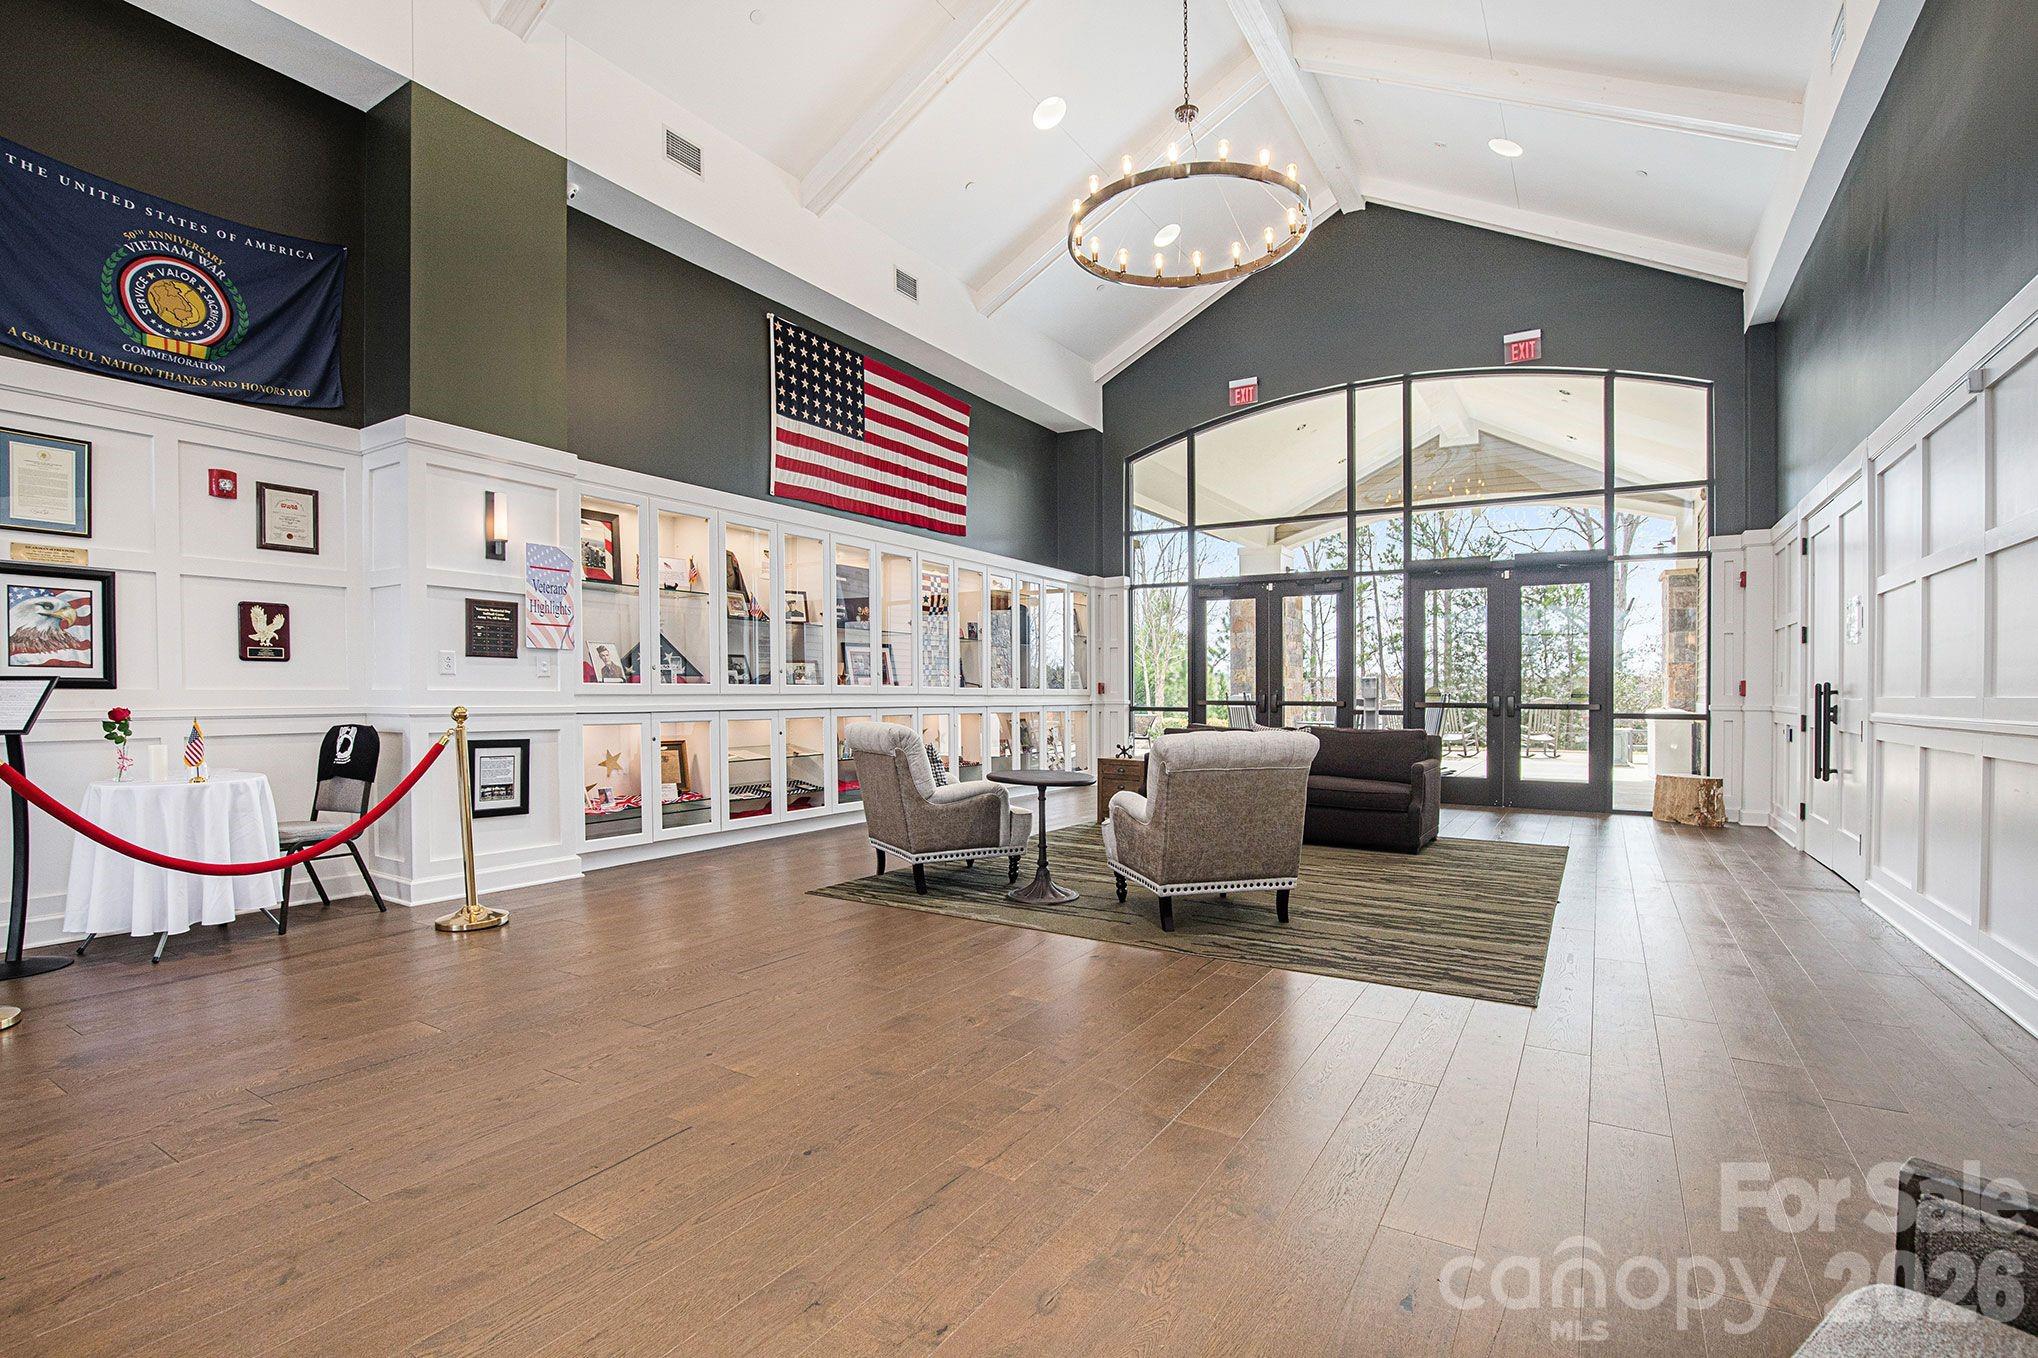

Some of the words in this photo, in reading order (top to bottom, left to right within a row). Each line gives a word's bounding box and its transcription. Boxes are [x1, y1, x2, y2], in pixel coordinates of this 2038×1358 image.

[5, 152, 48, 178] THE
[58, 174, 136, 210] UNITED
[145, 207, 208, 234] STATES
[216, 229, 237, 242] OF
[244, 238, 314, 261] AMERICA
[124, 240, 194, 260] VIETNAM
[198, 255, 226, 280] WAR
[148, 230, 226, 266] ANNIVERSARY
[156, 267, 197, 285] VALOR
[134, 276, 152, 316] SERVICE
[203, 293, 219, 331] SACRIFICE
[7, 326, 18, 337] A
[21, 331, 97, 362] GRATEFUL
[100, 355, 153, 375] NATION
[156, 369, 208, 387] THANKS
[210, 380, 238, 389] AND
[241, 382, 285, 396] HONORS
[287, 388, 311, 398] YOU
[122, 343, 226, 373] COMMEMORATION
[1511, 340, 1536, 361] EXIT
[1234, 386, 1254, 404] EXIT
[532, 579, 569, 595] Veterans'
[529, 599, 572, 618] Highlights
